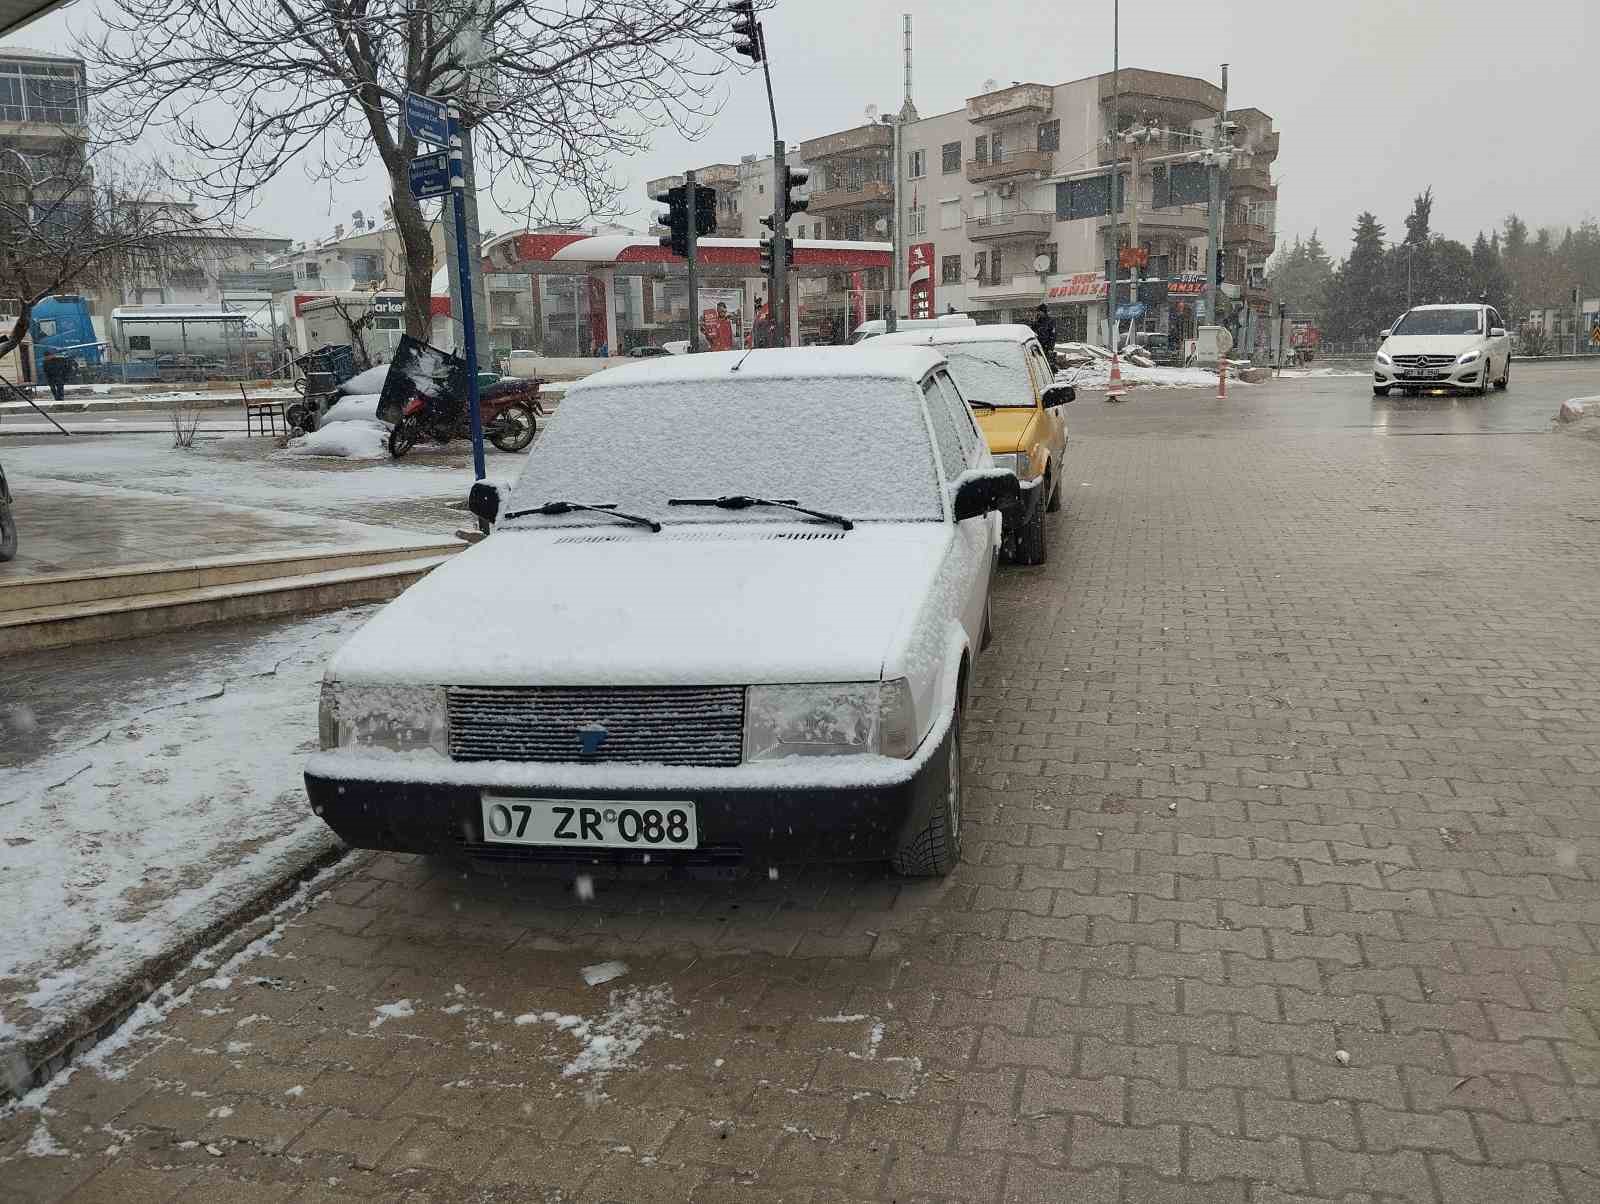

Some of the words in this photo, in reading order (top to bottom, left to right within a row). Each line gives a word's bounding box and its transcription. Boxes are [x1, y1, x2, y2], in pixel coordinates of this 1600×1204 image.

[373, 301, 405, 312] arke
[489, 804, 532, 837] 07
[552, 807, 603, 840] ZR
[617, 809, 689, 843] 088
